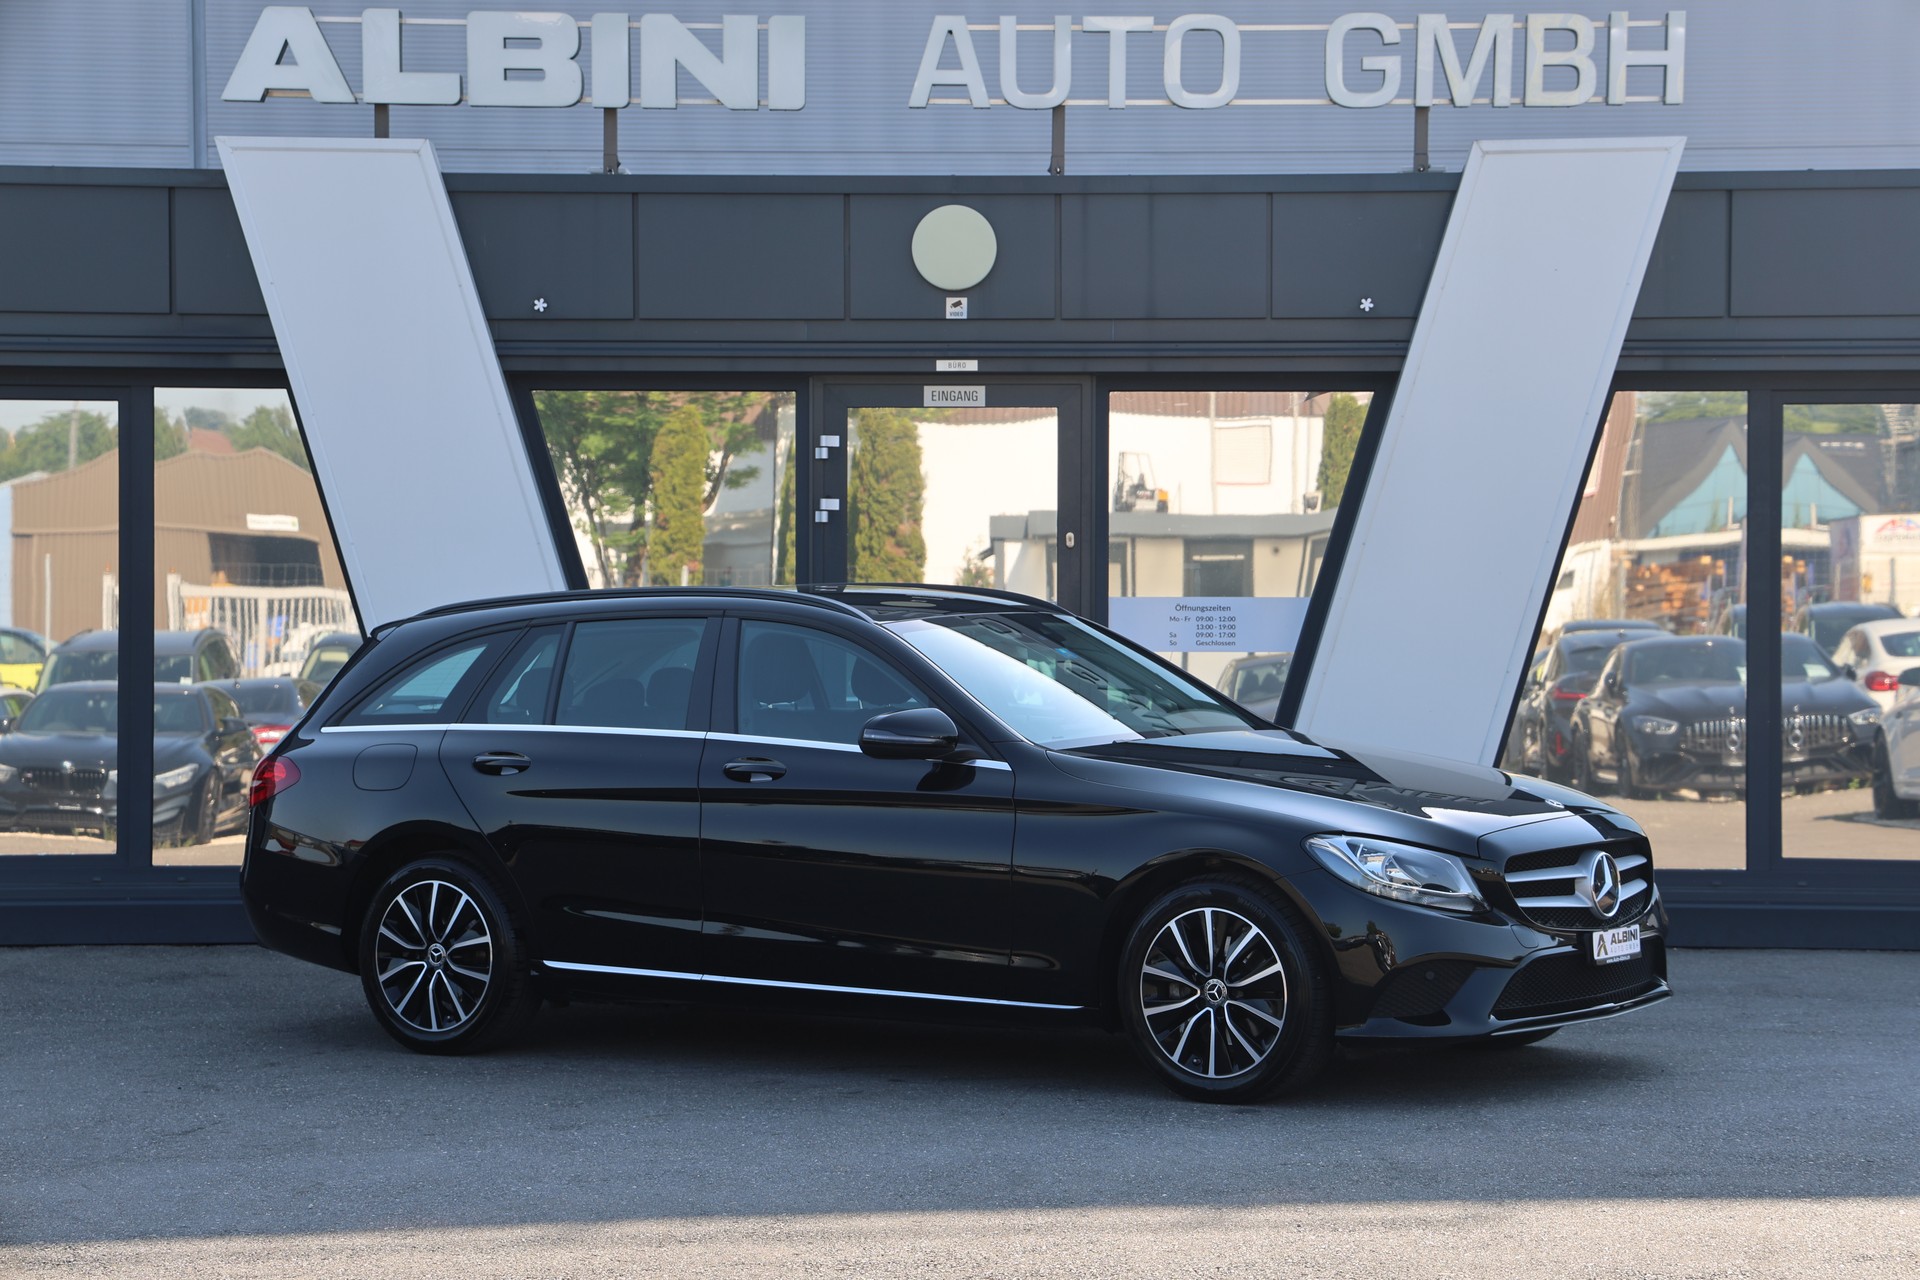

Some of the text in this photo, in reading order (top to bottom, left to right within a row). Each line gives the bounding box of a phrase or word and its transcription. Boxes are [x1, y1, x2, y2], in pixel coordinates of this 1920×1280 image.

[220, 6, 1687, 111] ALBINI AUTO GMBH
[931, 390, 979, 402] EINGANG
[1174, 603, 1232, 613] Öffnungszeiten
[1610, 929, 1638, 945] ALBINI
